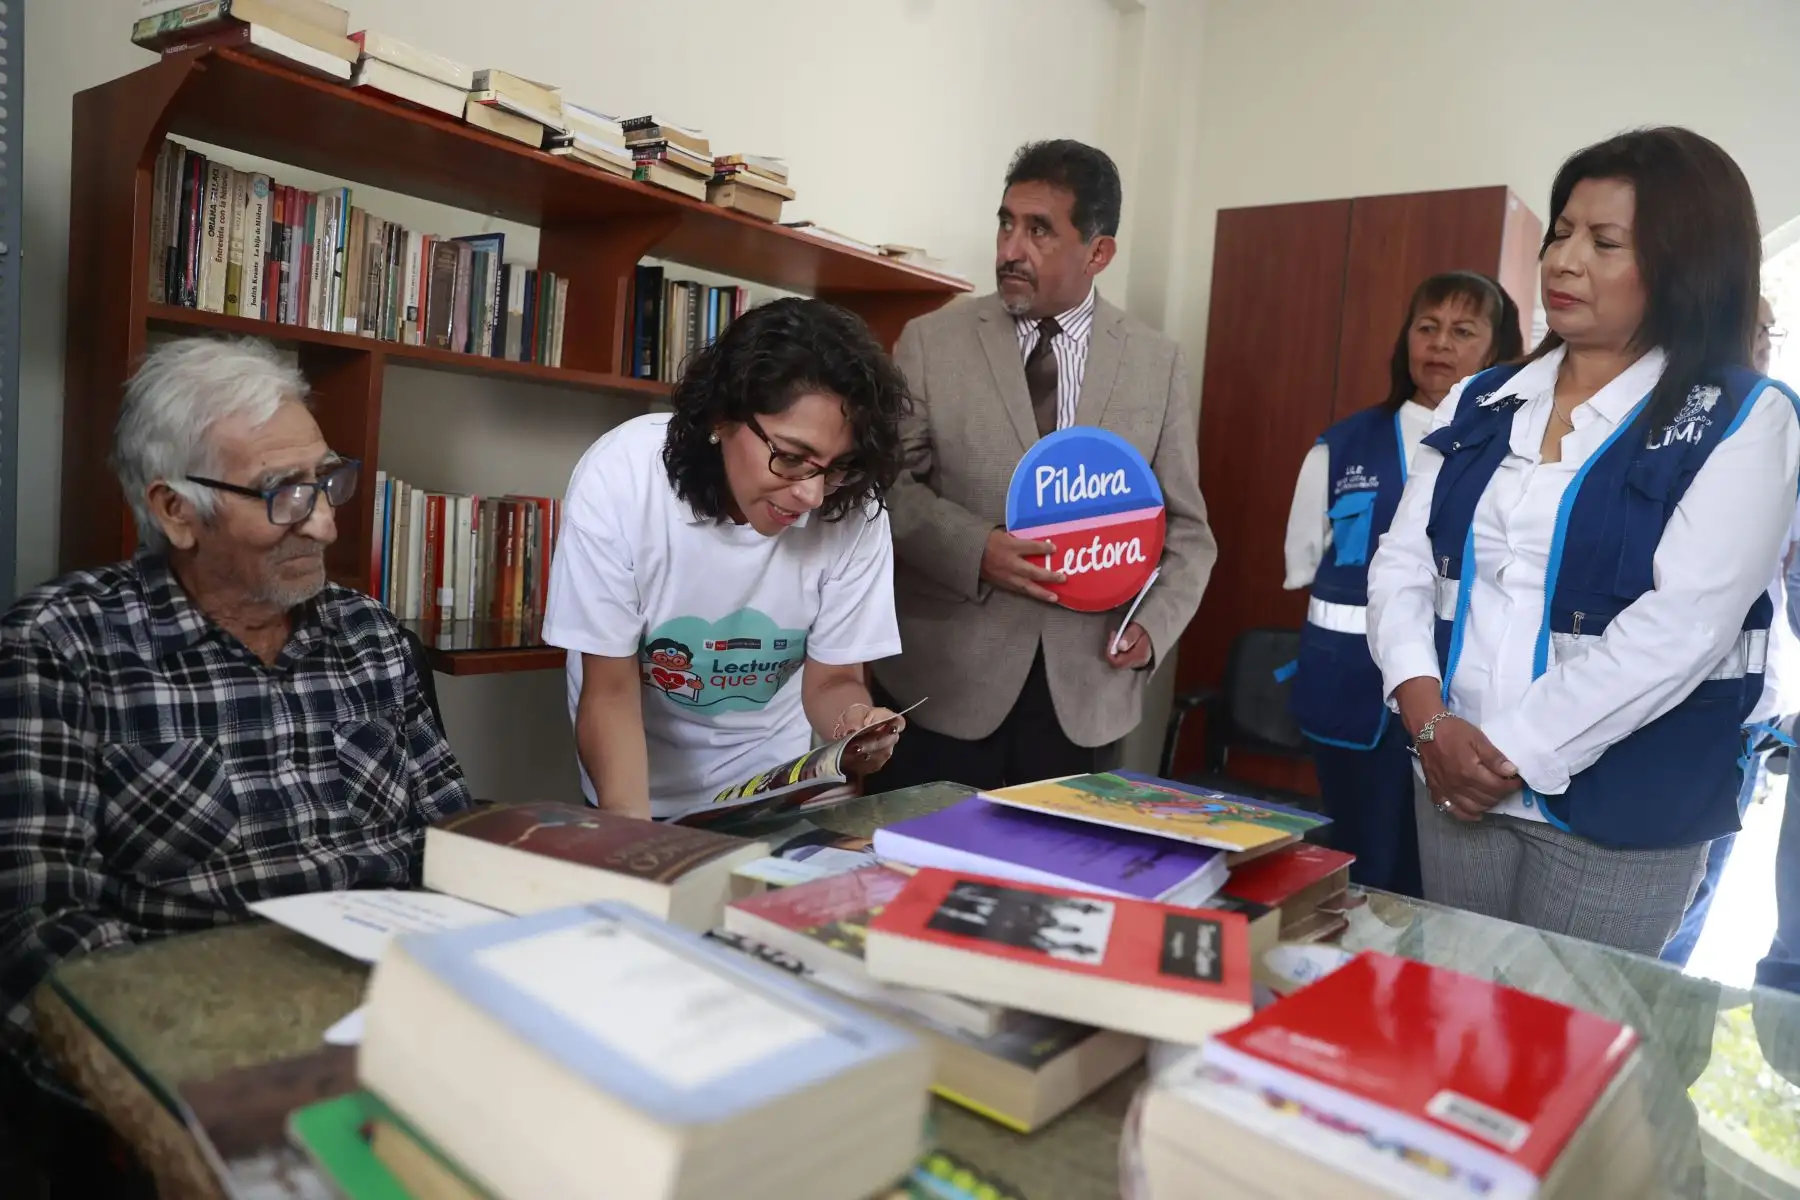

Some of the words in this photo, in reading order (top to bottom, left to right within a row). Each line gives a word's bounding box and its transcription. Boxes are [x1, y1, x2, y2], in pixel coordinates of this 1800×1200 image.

[208, 202, 217, 238] ORIANA
[215, 226, 225, 263] Entrevista
[250, 285, 258, 307] Judith
[254, 235, 262, 248] hija
[1035, 463, 1131, 507] Píldora
[1043, 535, 1146, 577] Lectora
[710, 674, 757, 690] que
